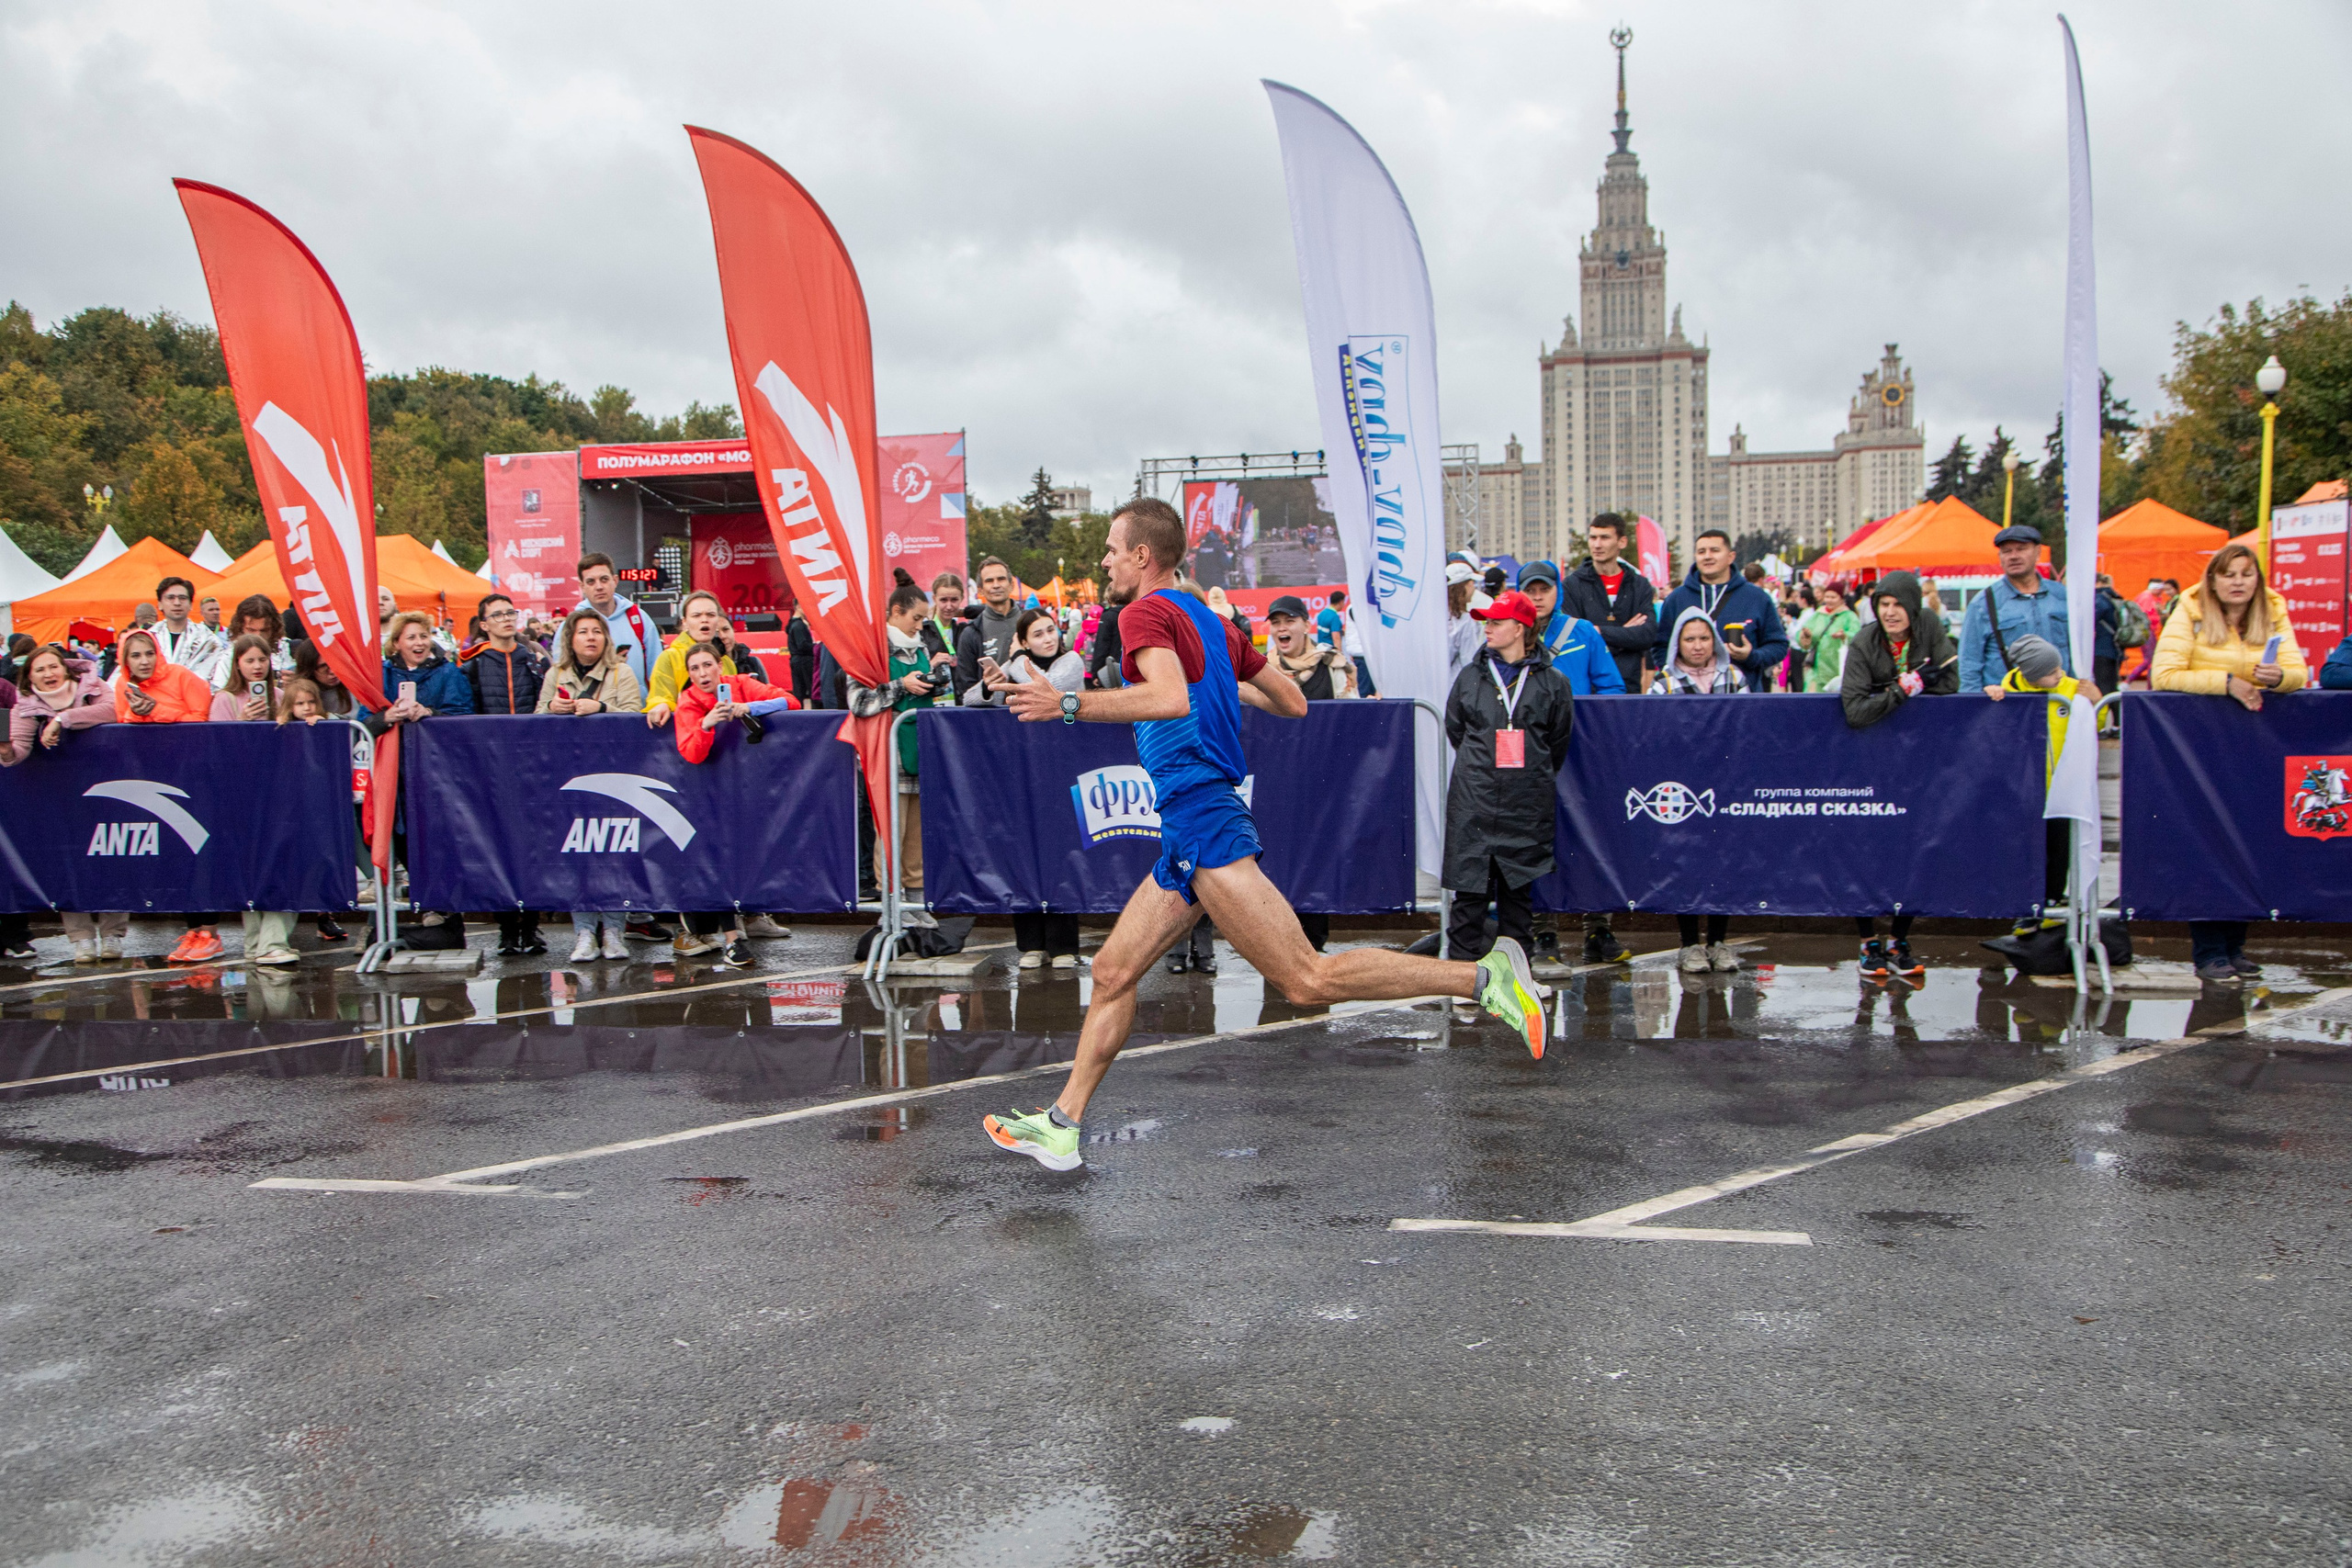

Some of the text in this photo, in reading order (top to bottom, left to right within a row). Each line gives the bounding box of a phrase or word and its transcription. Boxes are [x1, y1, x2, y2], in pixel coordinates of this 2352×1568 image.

[597, 449, 753, 469] ПОЛУМАРАФОН «МО
[1754, 785, 1874, 799] группа компаний
[1719, 802, 1907, 818] «СЛАДКАЯ СКАЗКА»
[86, 821, 160, 857] ANTA
[560, 817, 640, 853] ANTA
